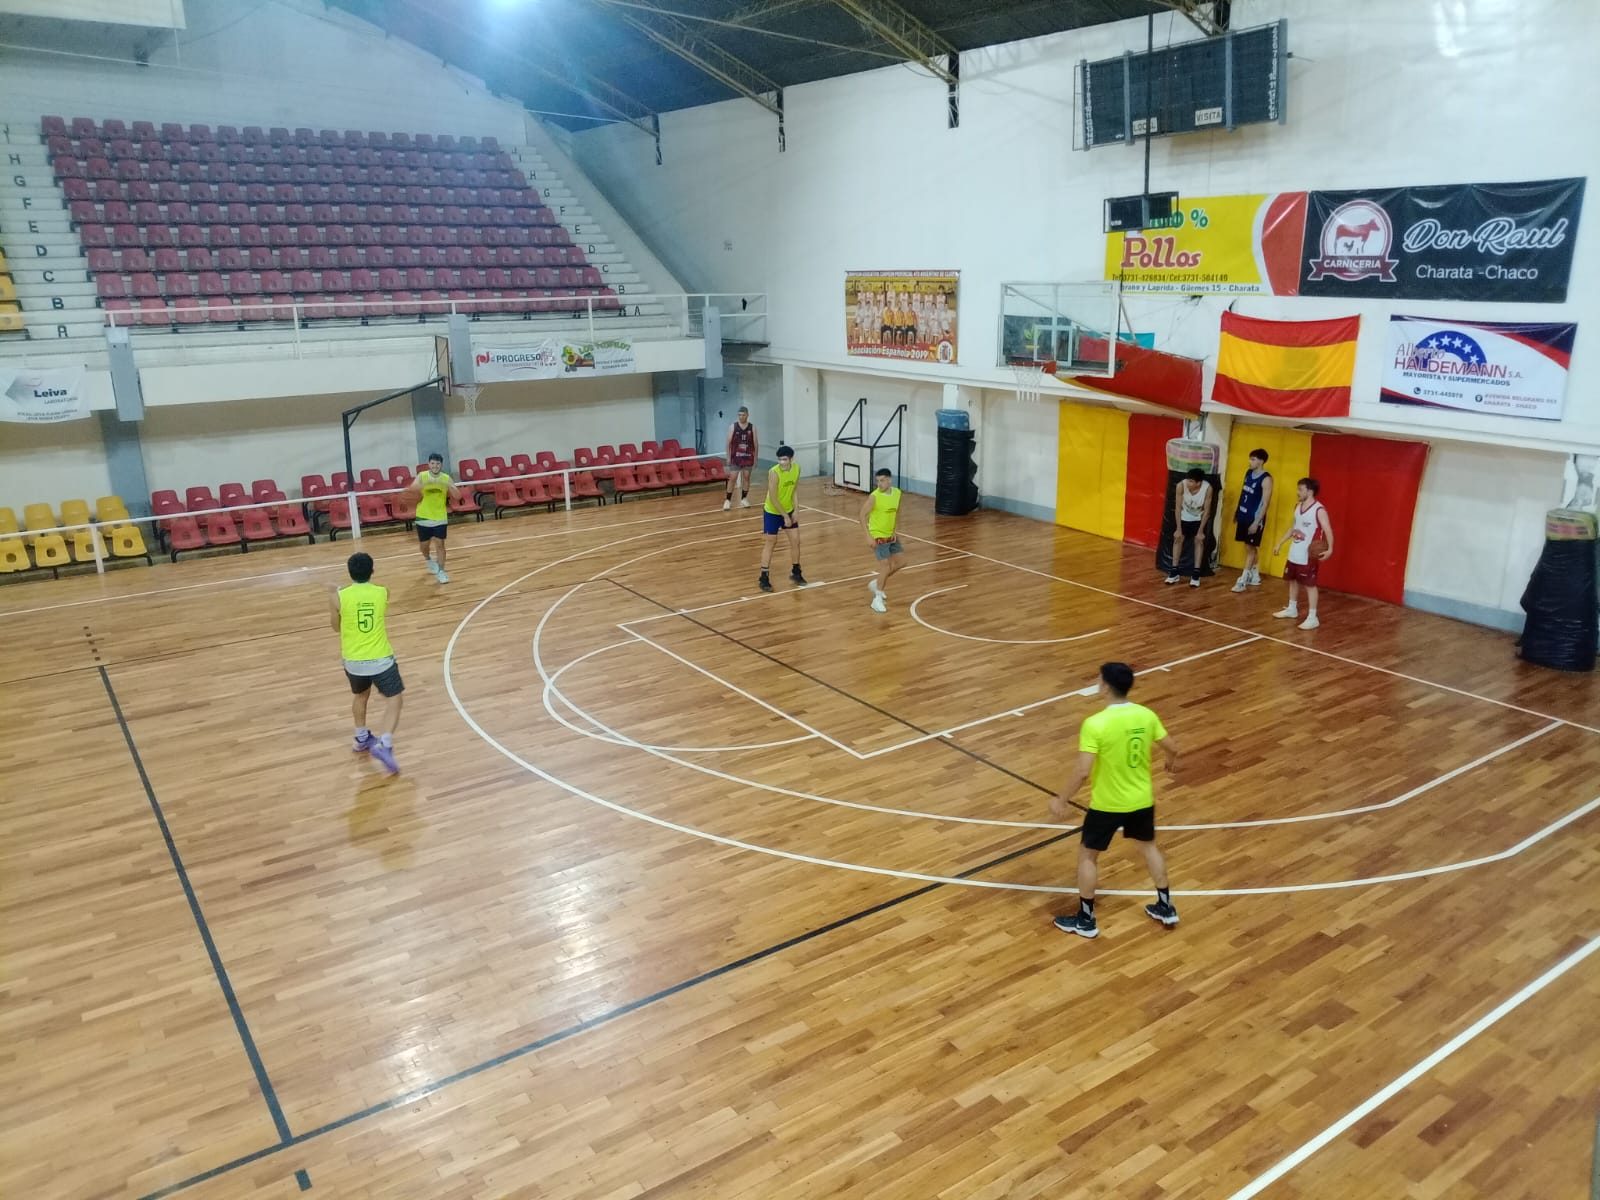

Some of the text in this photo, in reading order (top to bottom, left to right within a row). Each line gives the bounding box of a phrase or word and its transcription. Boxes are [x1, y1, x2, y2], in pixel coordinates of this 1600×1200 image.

[1196, 111, 1221, 122] VISITA
[1133, 120, 1156, 132] LOCL
[8, 153, 21, 165] H
[14, 175, 26, 187] G
[530, 170, 537, 180] H
[543, 188, 550, 198] G
[22, 197, 31, 209] F
[559, 206, 565, 216] F
[1190, 208, 1209, 228] %
[28, 220, 39, 233] E
[574, 224, 581, 235] E
[1403, 216, 1568, 255] Don Raul
[35, 244, 47, 257] D
[588, 244, 595, 254] D
[1121, 236, 1202, 269] Pollos
[602, 264, 609, 273] C
[1323, 258, 1382, 269] CARNICERIA
[43, 270, 55, 282] C
[1415, 264, 1473, 280] Charata
[618, 284, 625, 294] B
[1229, 283, 1260, 293] Charata
[51, 297, 64, 310] B
[634, 305, 641, 316] A
[496, 353, 541, 363] PROGRESO
[1394, 356, 1508, 379] HALDEMANN
[1402, 371, 1442, 381] MAYORISTA
[1448, 375, 1511, 387] SUPERMERCADOS
[33, 388, 68, 398] Leiva
[357, 608, 374, 633] 5
[1126, 736, 1146, 769] 8
